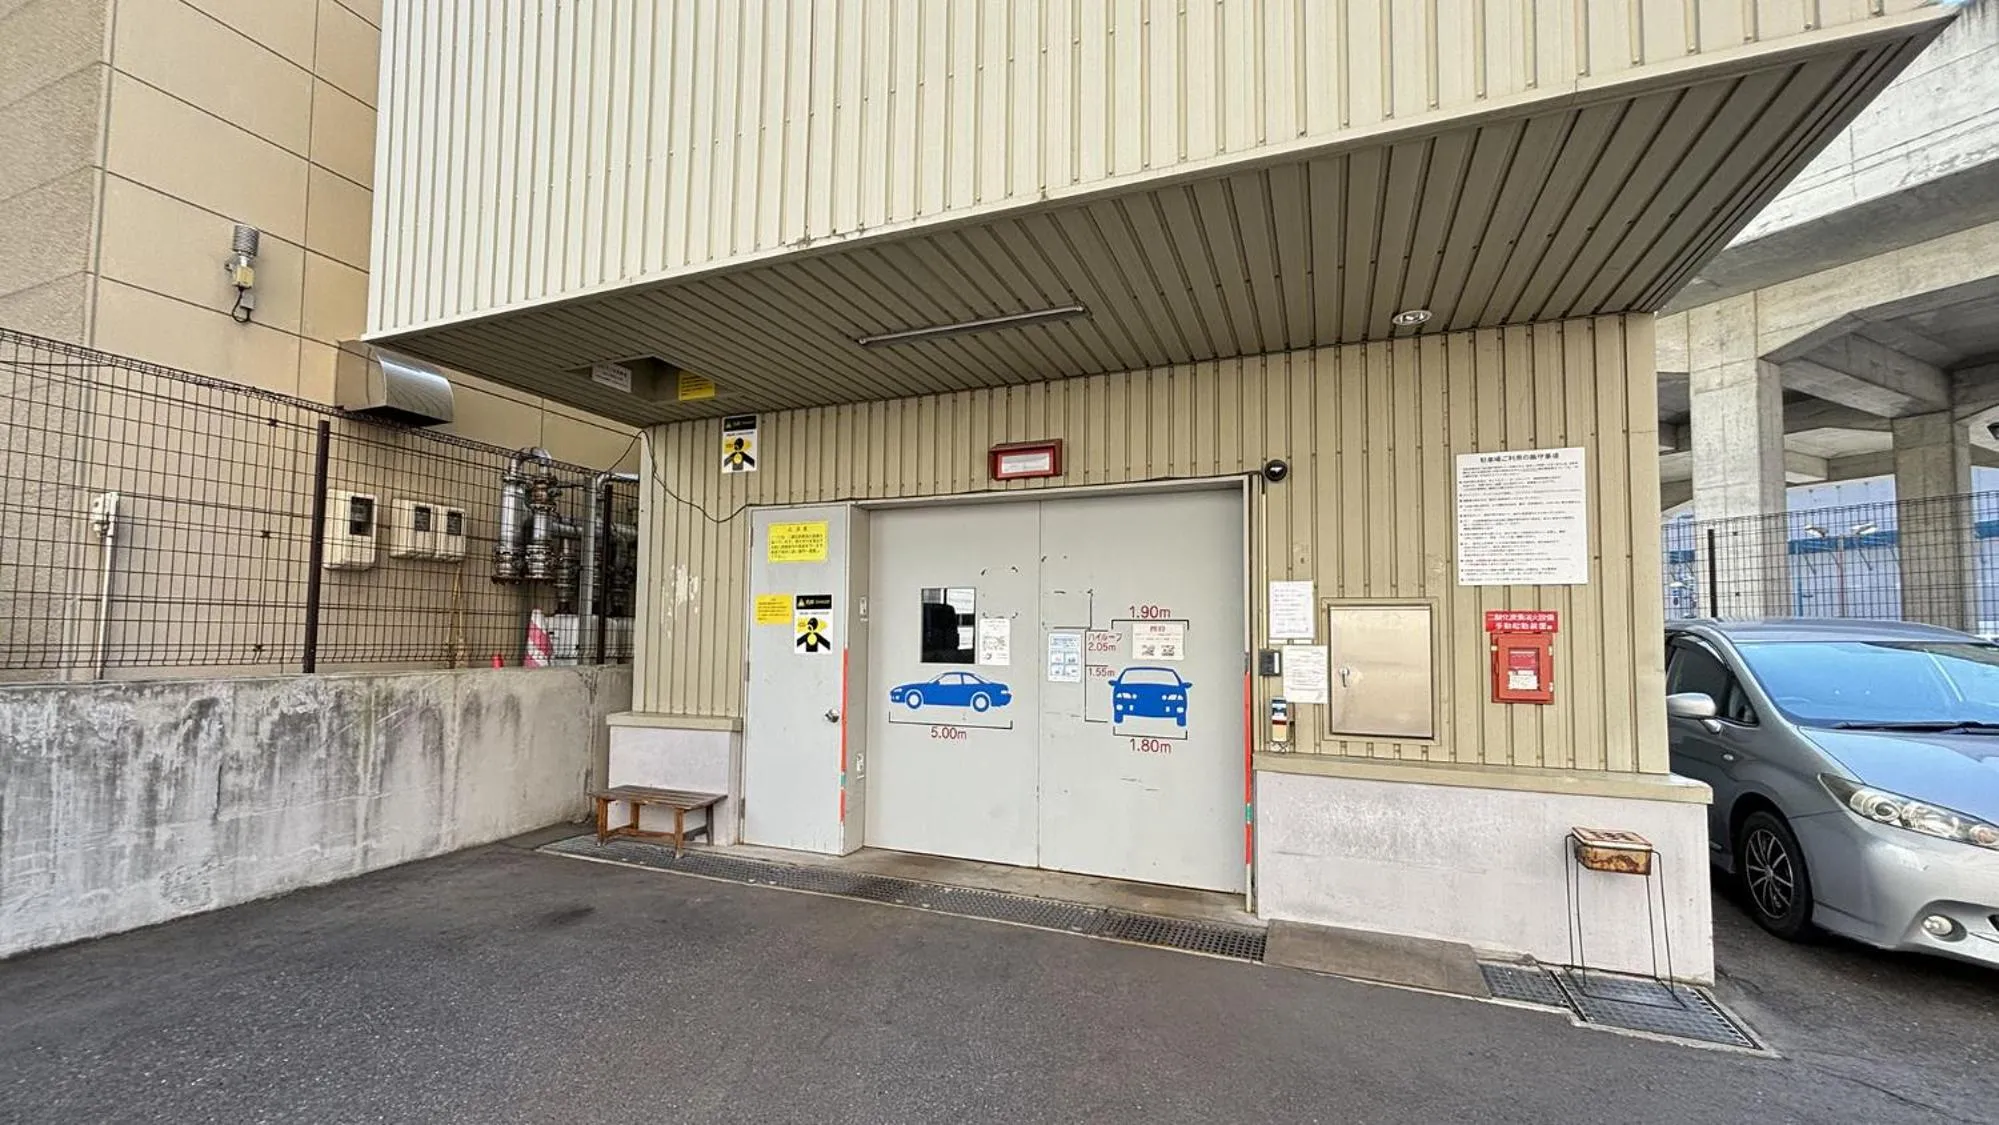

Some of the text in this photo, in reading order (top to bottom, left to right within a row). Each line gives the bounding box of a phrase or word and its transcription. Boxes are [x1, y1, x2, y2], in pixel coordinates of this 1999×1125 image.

[1129, 605, 1171, 618] 1.90m
[1088, 632, 1123, 642] ハイルーフ
[1088, 641, 1116, 652] 2.05m
[1089, 667, 1115, 678] 1.55m
[930, 726, 967, 740] 5.00m
[1129, 738, 1172, 754] 1.80m
